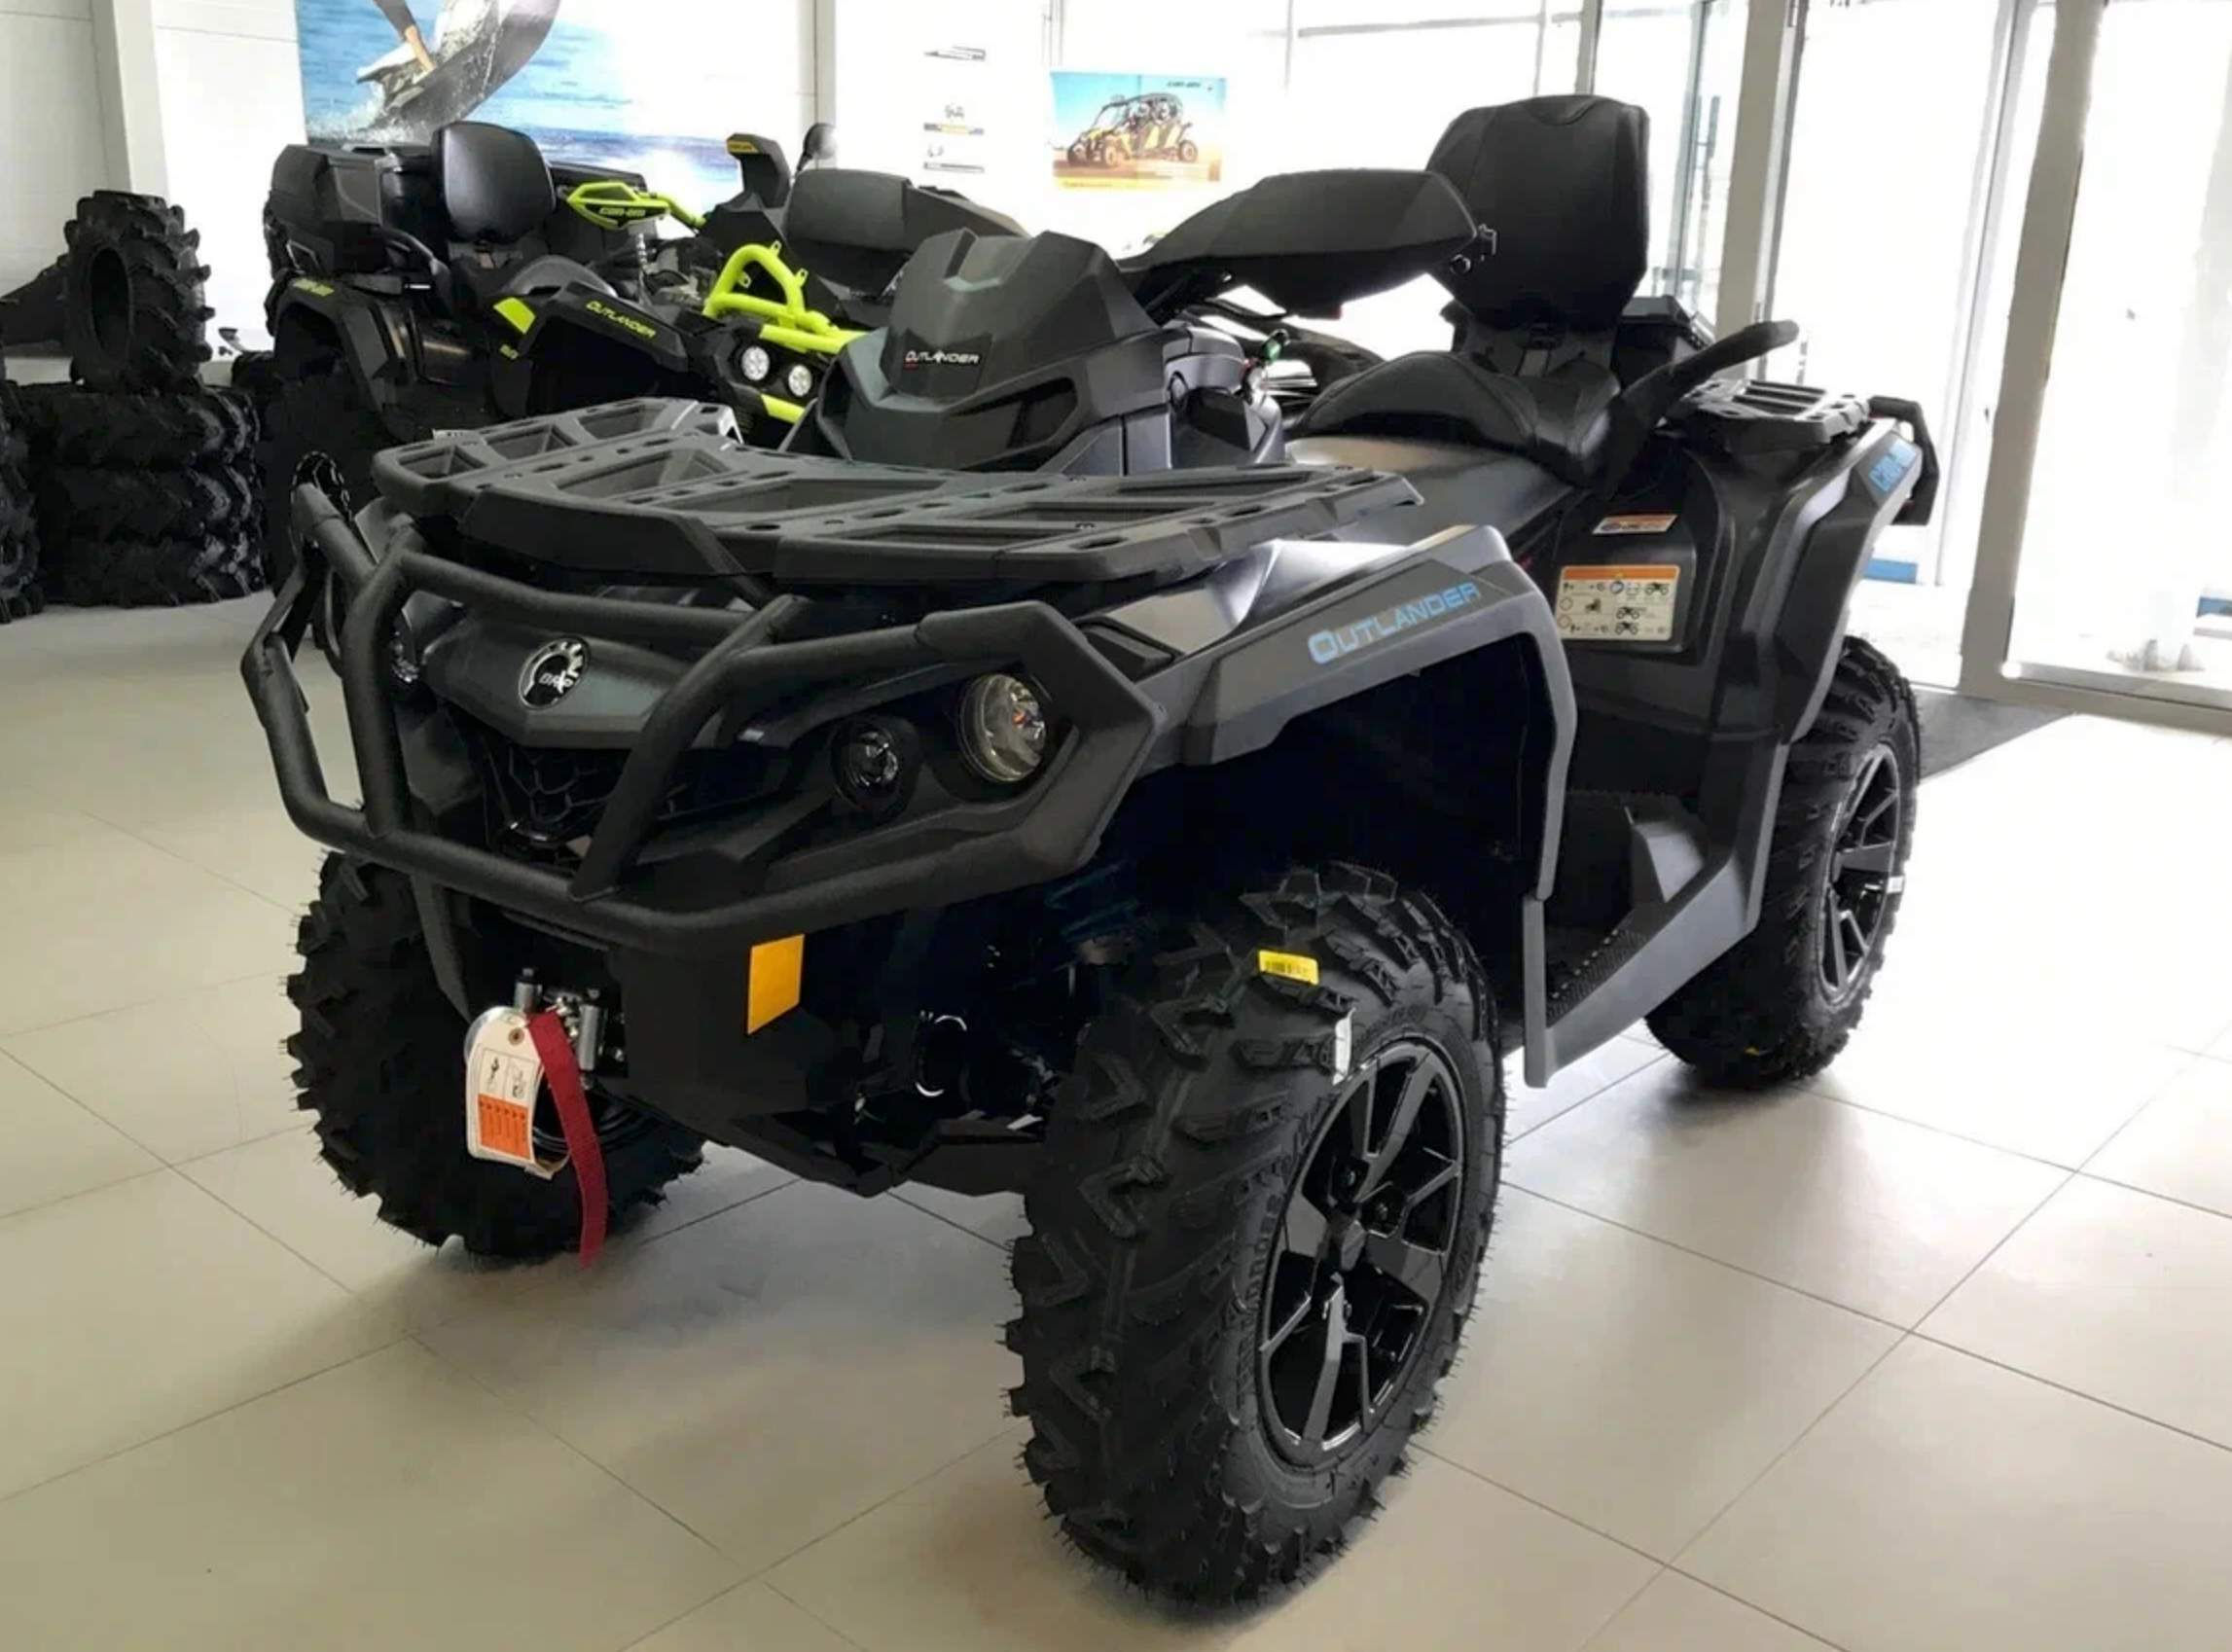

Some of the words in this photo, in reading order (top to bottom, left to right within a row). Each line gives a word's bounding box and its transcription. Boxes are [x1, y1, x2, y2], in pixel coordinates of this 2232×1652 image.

[586, 301, 656, 338] OUTLANDER
[905, 350, 980, 365] OUTLANDER
[1308, 581, 1482, 665] OUTLANDER
